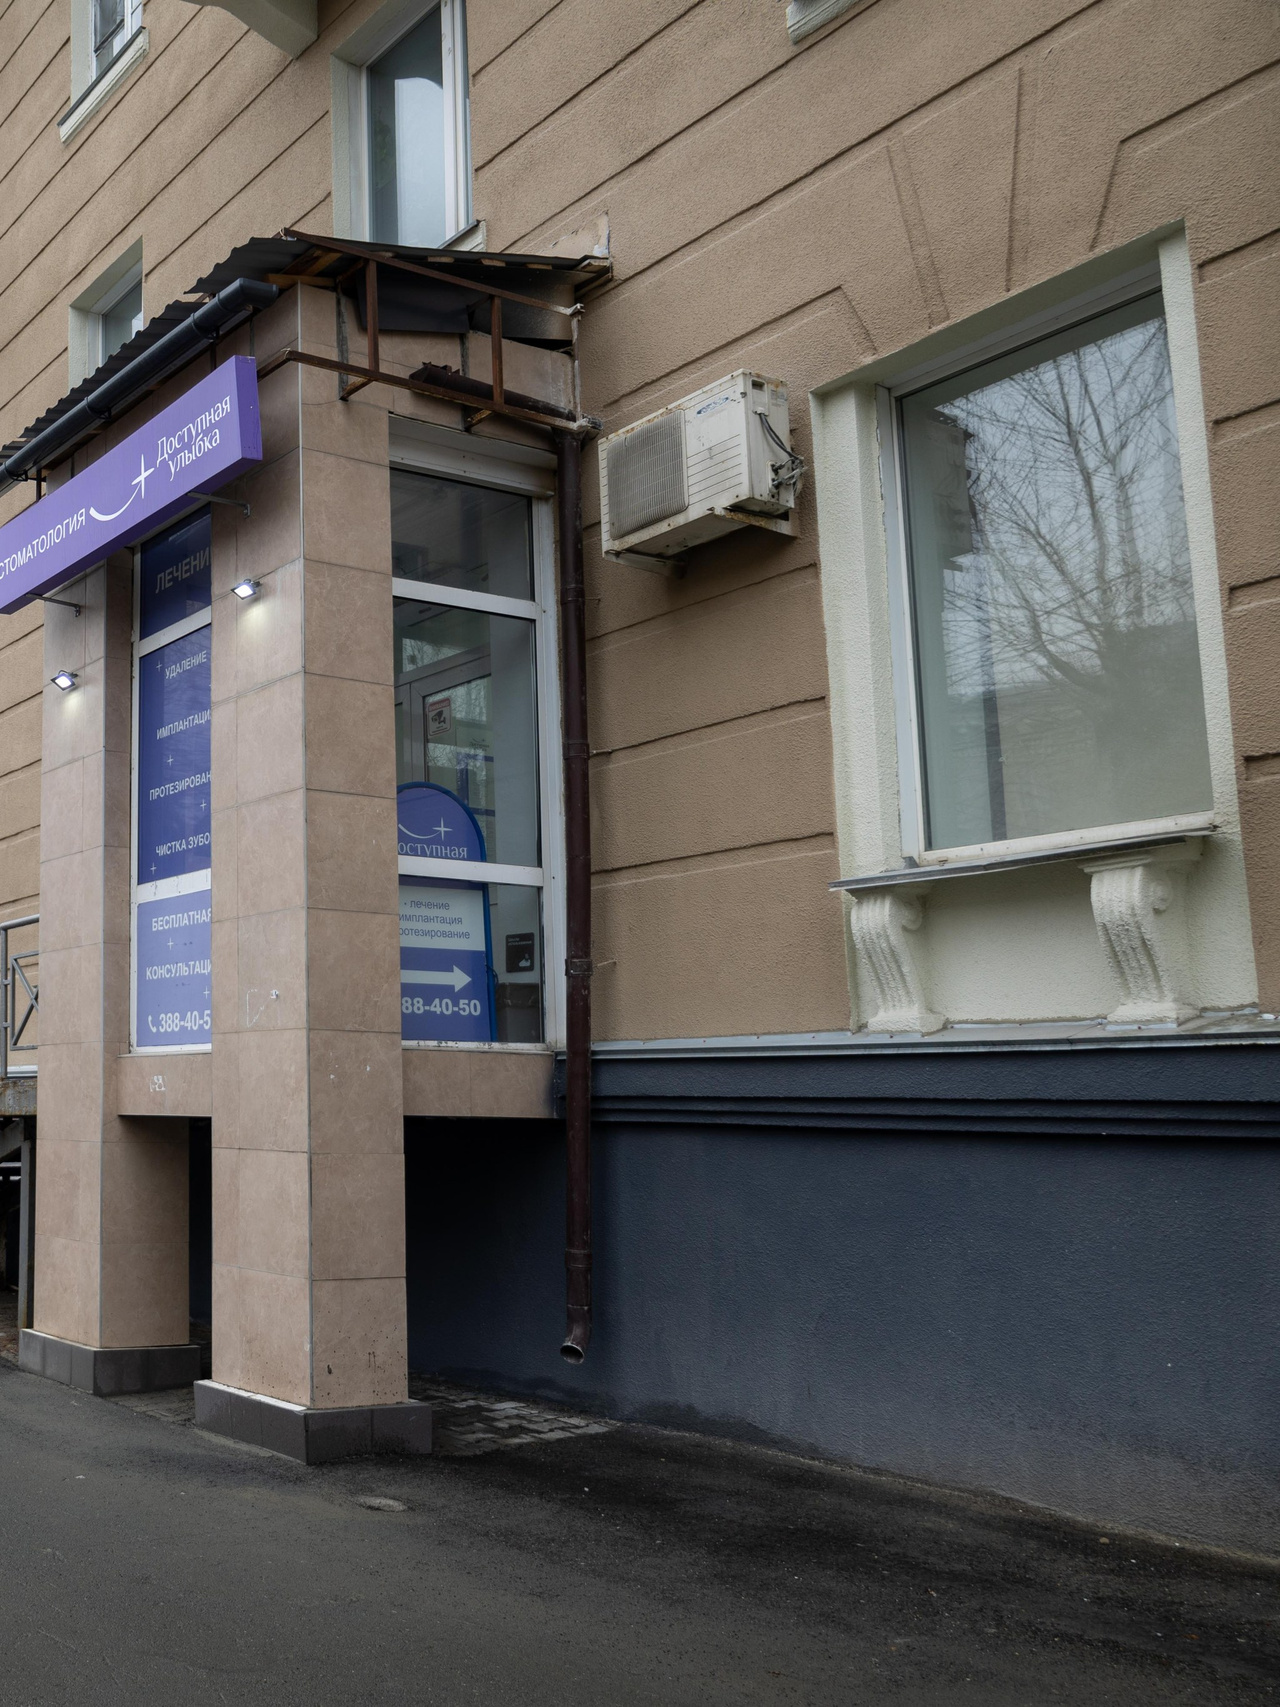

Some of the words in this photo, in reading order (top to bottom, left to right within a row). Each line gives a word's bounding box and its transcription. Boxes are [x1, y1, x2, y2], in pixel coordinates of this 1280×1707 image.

[157, 395, 230, 468] Доступная
[168, 429, 220, 481] улыбка
[155, 546, 210, 594] ЛЕЧЕНИ
[165, 650, 207, 679] УДАЛЕНИЕ
[156, 708, 211, 740] ИМПЛАНТАЦИ
[149, 770, 211, 801] ПРОТЕЗИРОВАН
[155, 839, 187, 856] ЧИСТКА
[398, 842, 467, 859] оступная
[410, 900, 450, 910] лечение
[399, 913, 463, 926] имплантация
[401, 996, 481, 1016] 88-40-50
[159, 1010, 211, 1032] 388-40-5
